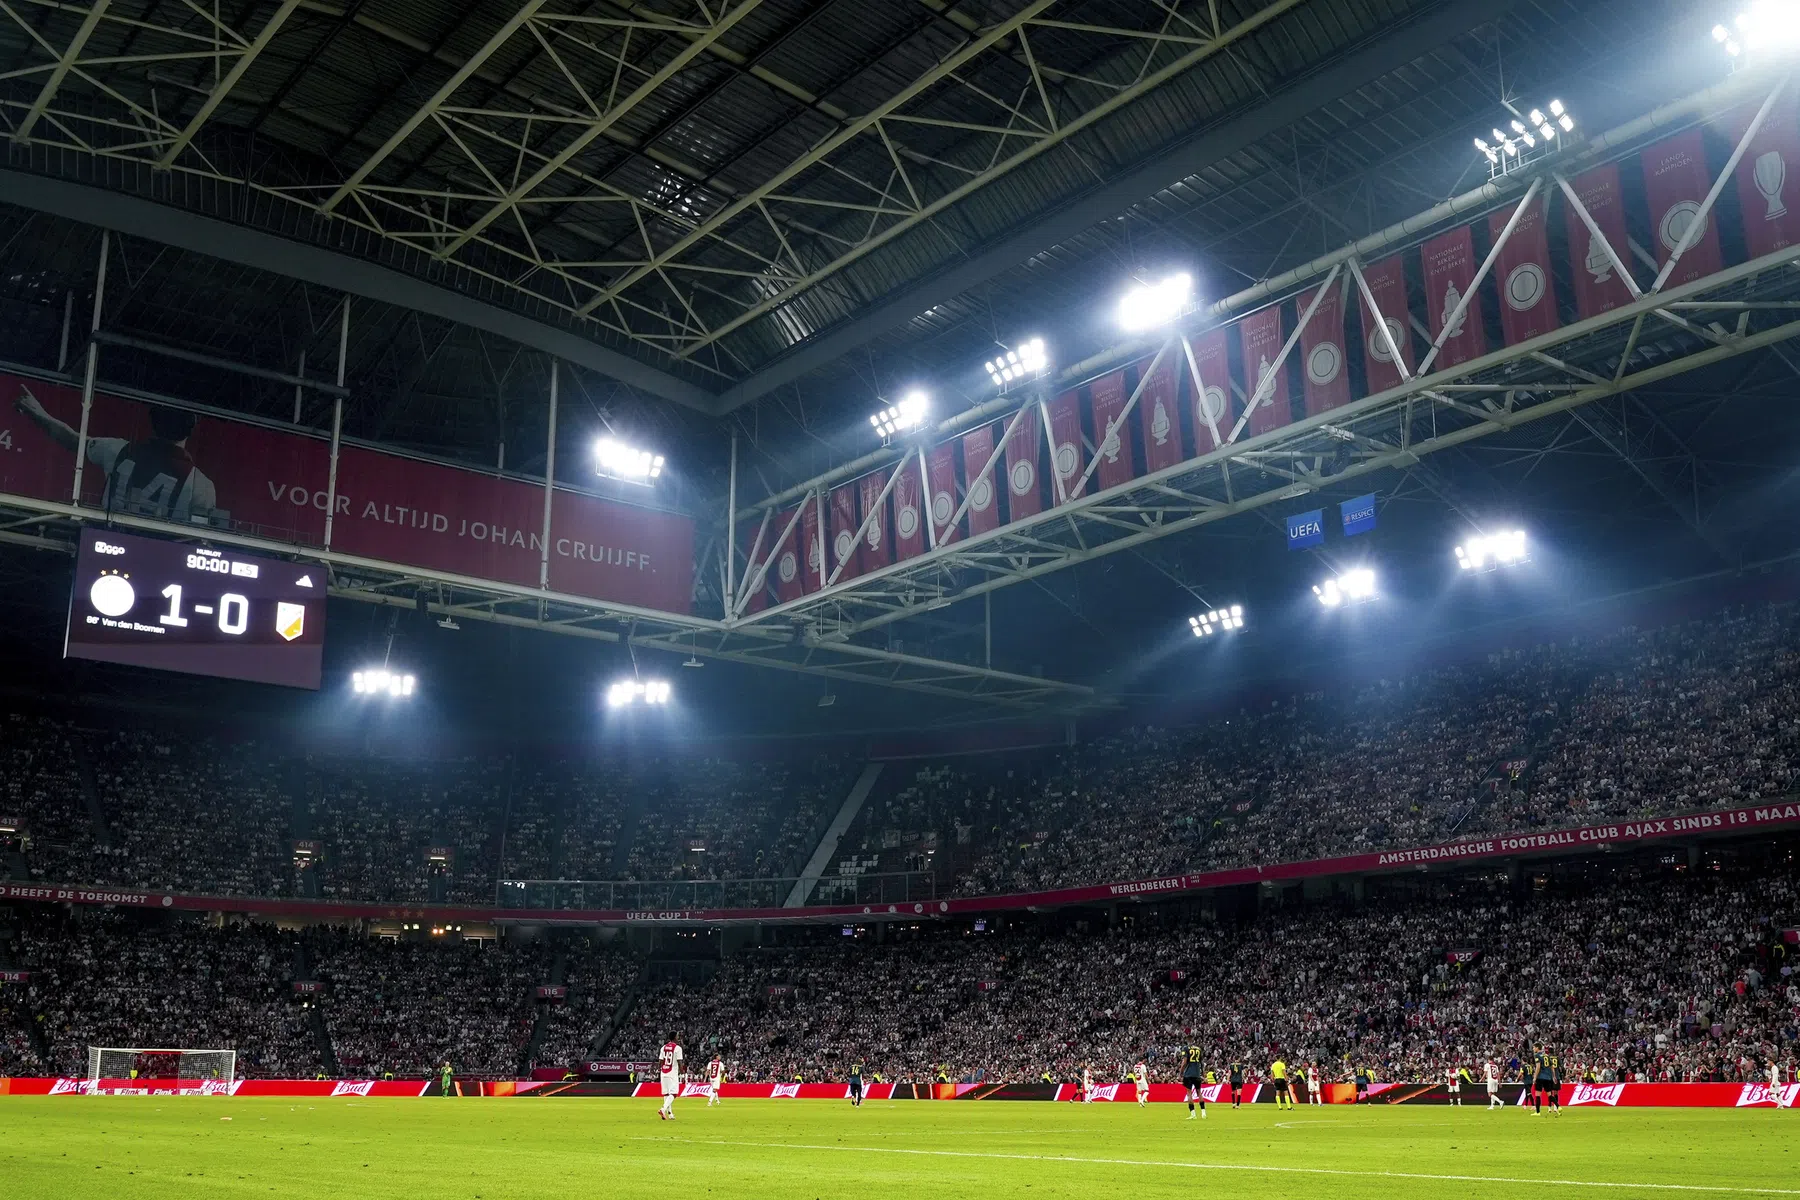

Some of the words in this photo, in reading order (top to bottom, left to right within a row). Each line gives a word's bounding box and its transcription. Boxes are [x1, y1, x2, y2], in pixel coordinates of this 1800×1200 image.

[268, 481, 351, 516] VOOR
[362, 500, 449, 533] ALTIJD
[458, 519, 543, 553] JOHAN
[1350, 508, 1375, 521] RESPECT
[1290, 521, 1321, 539] UEFA
[186, 554, 230, 574] 90:00
[101, 617, 117, 628] Van
[117, 620, 133, 630] den
[133, 622, 166, 635] Boomen
[1378, 841, 1495, 865] AMSTERDAMSCHE
[1501, 832, 1575, 851] FOOTBALL
[1579, 827, 1619, 841] CLUB
[1624, 821, 1667, 838] AJAX
[1673, 814, 1722, 831] SINDS
[1729, 811, 1748, 824] 18
[1755, 804, 1800, 822] MAA
[1110, 879, 1179, 895] WERELDBEKER
[10, 887, 53, 898] HEEFT
[58, 890, 74, 899] DE
[79, 891, 147, 904] TOEKOMST
[626, 912, 655, 920] UEFA
[659, 912, 681, 920] CUP
[301, 983, 315, 991] 115
[339, 1081, 367, 1093] Bud
[687, 1082, 712, 1094] Bud
[775, 1083, 796, 1095] Bud
[1578, 1084, 1617, 1101] Bud
